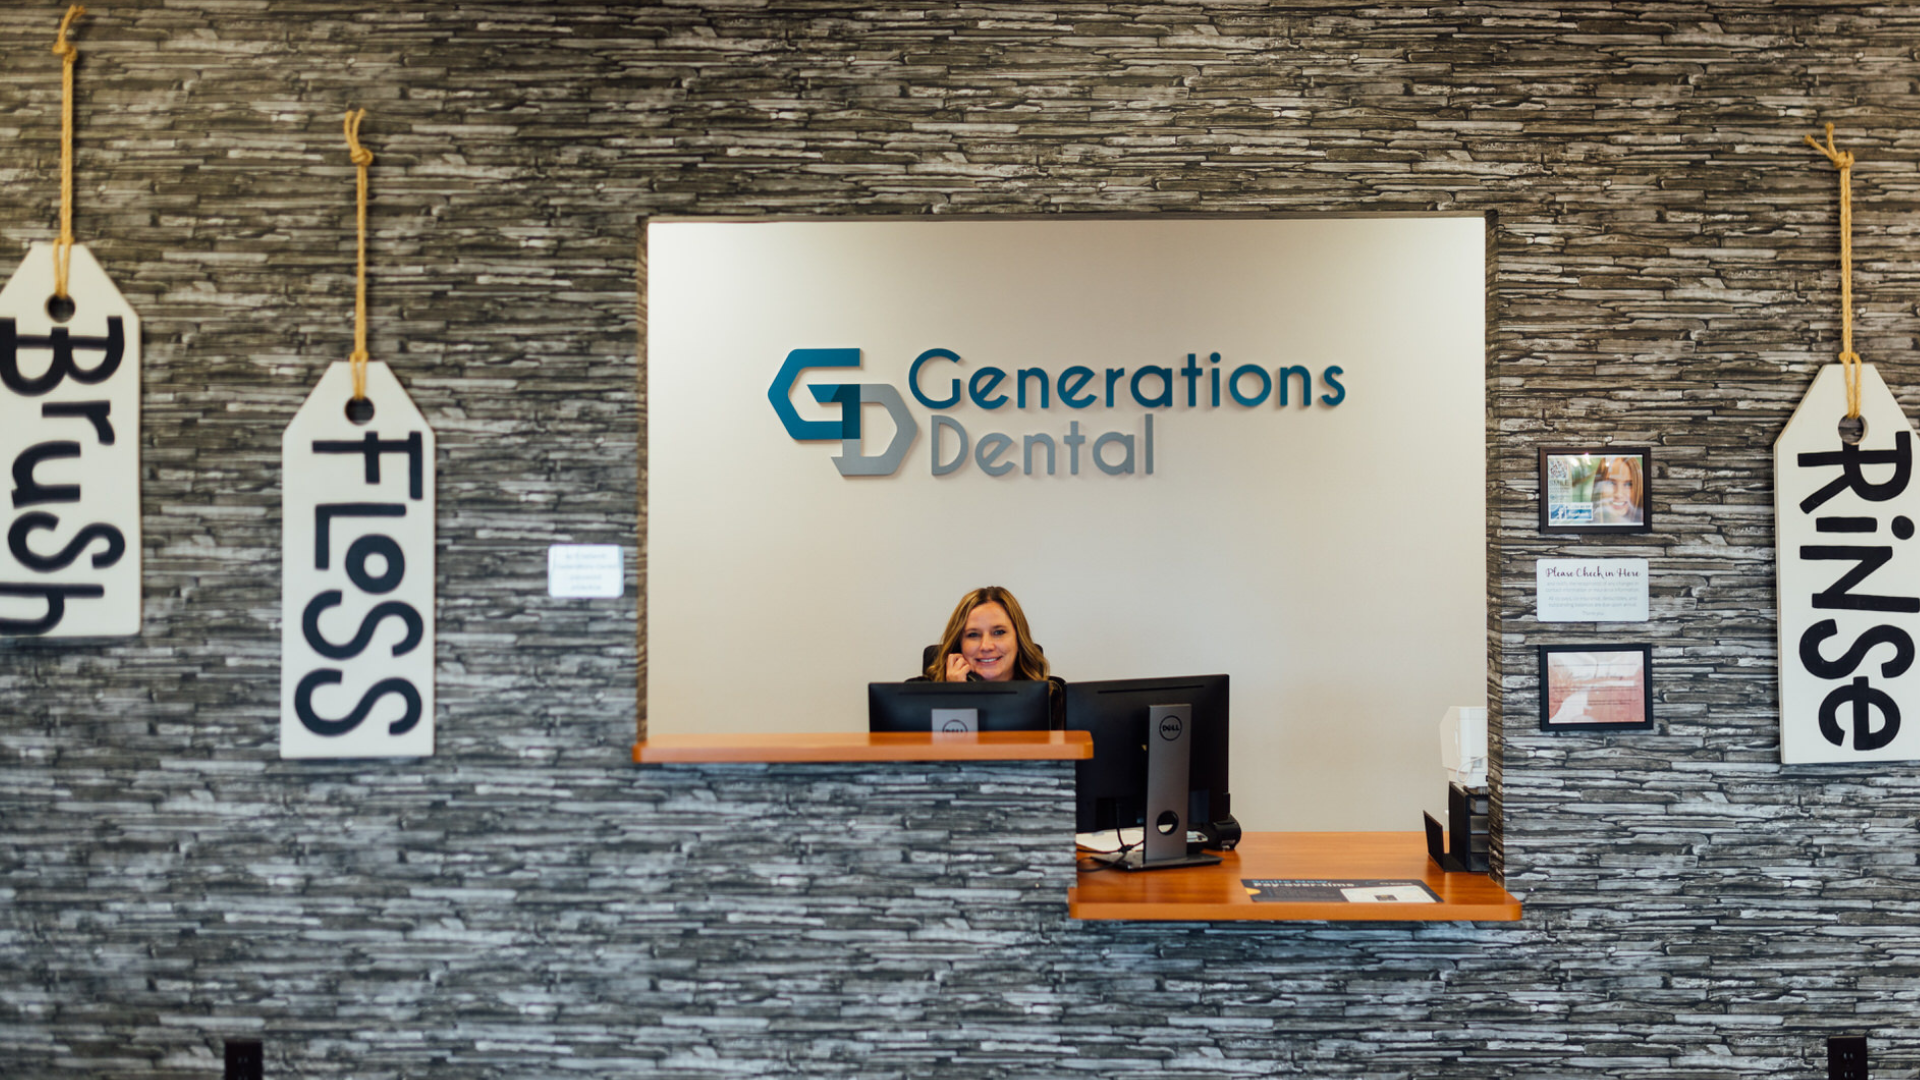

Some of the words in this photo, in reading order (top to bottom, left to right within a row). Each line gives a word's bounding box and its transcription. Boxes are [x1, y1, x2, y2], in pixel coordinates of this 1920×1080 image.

[908, 347, 1347, 410] Generations
[930, 413, 1155, 476] Dental
[1545, 566, 1573, 577] Please
[1576, 565, 1605, 579] Check
[1616, 567, 1641, 578] Here
